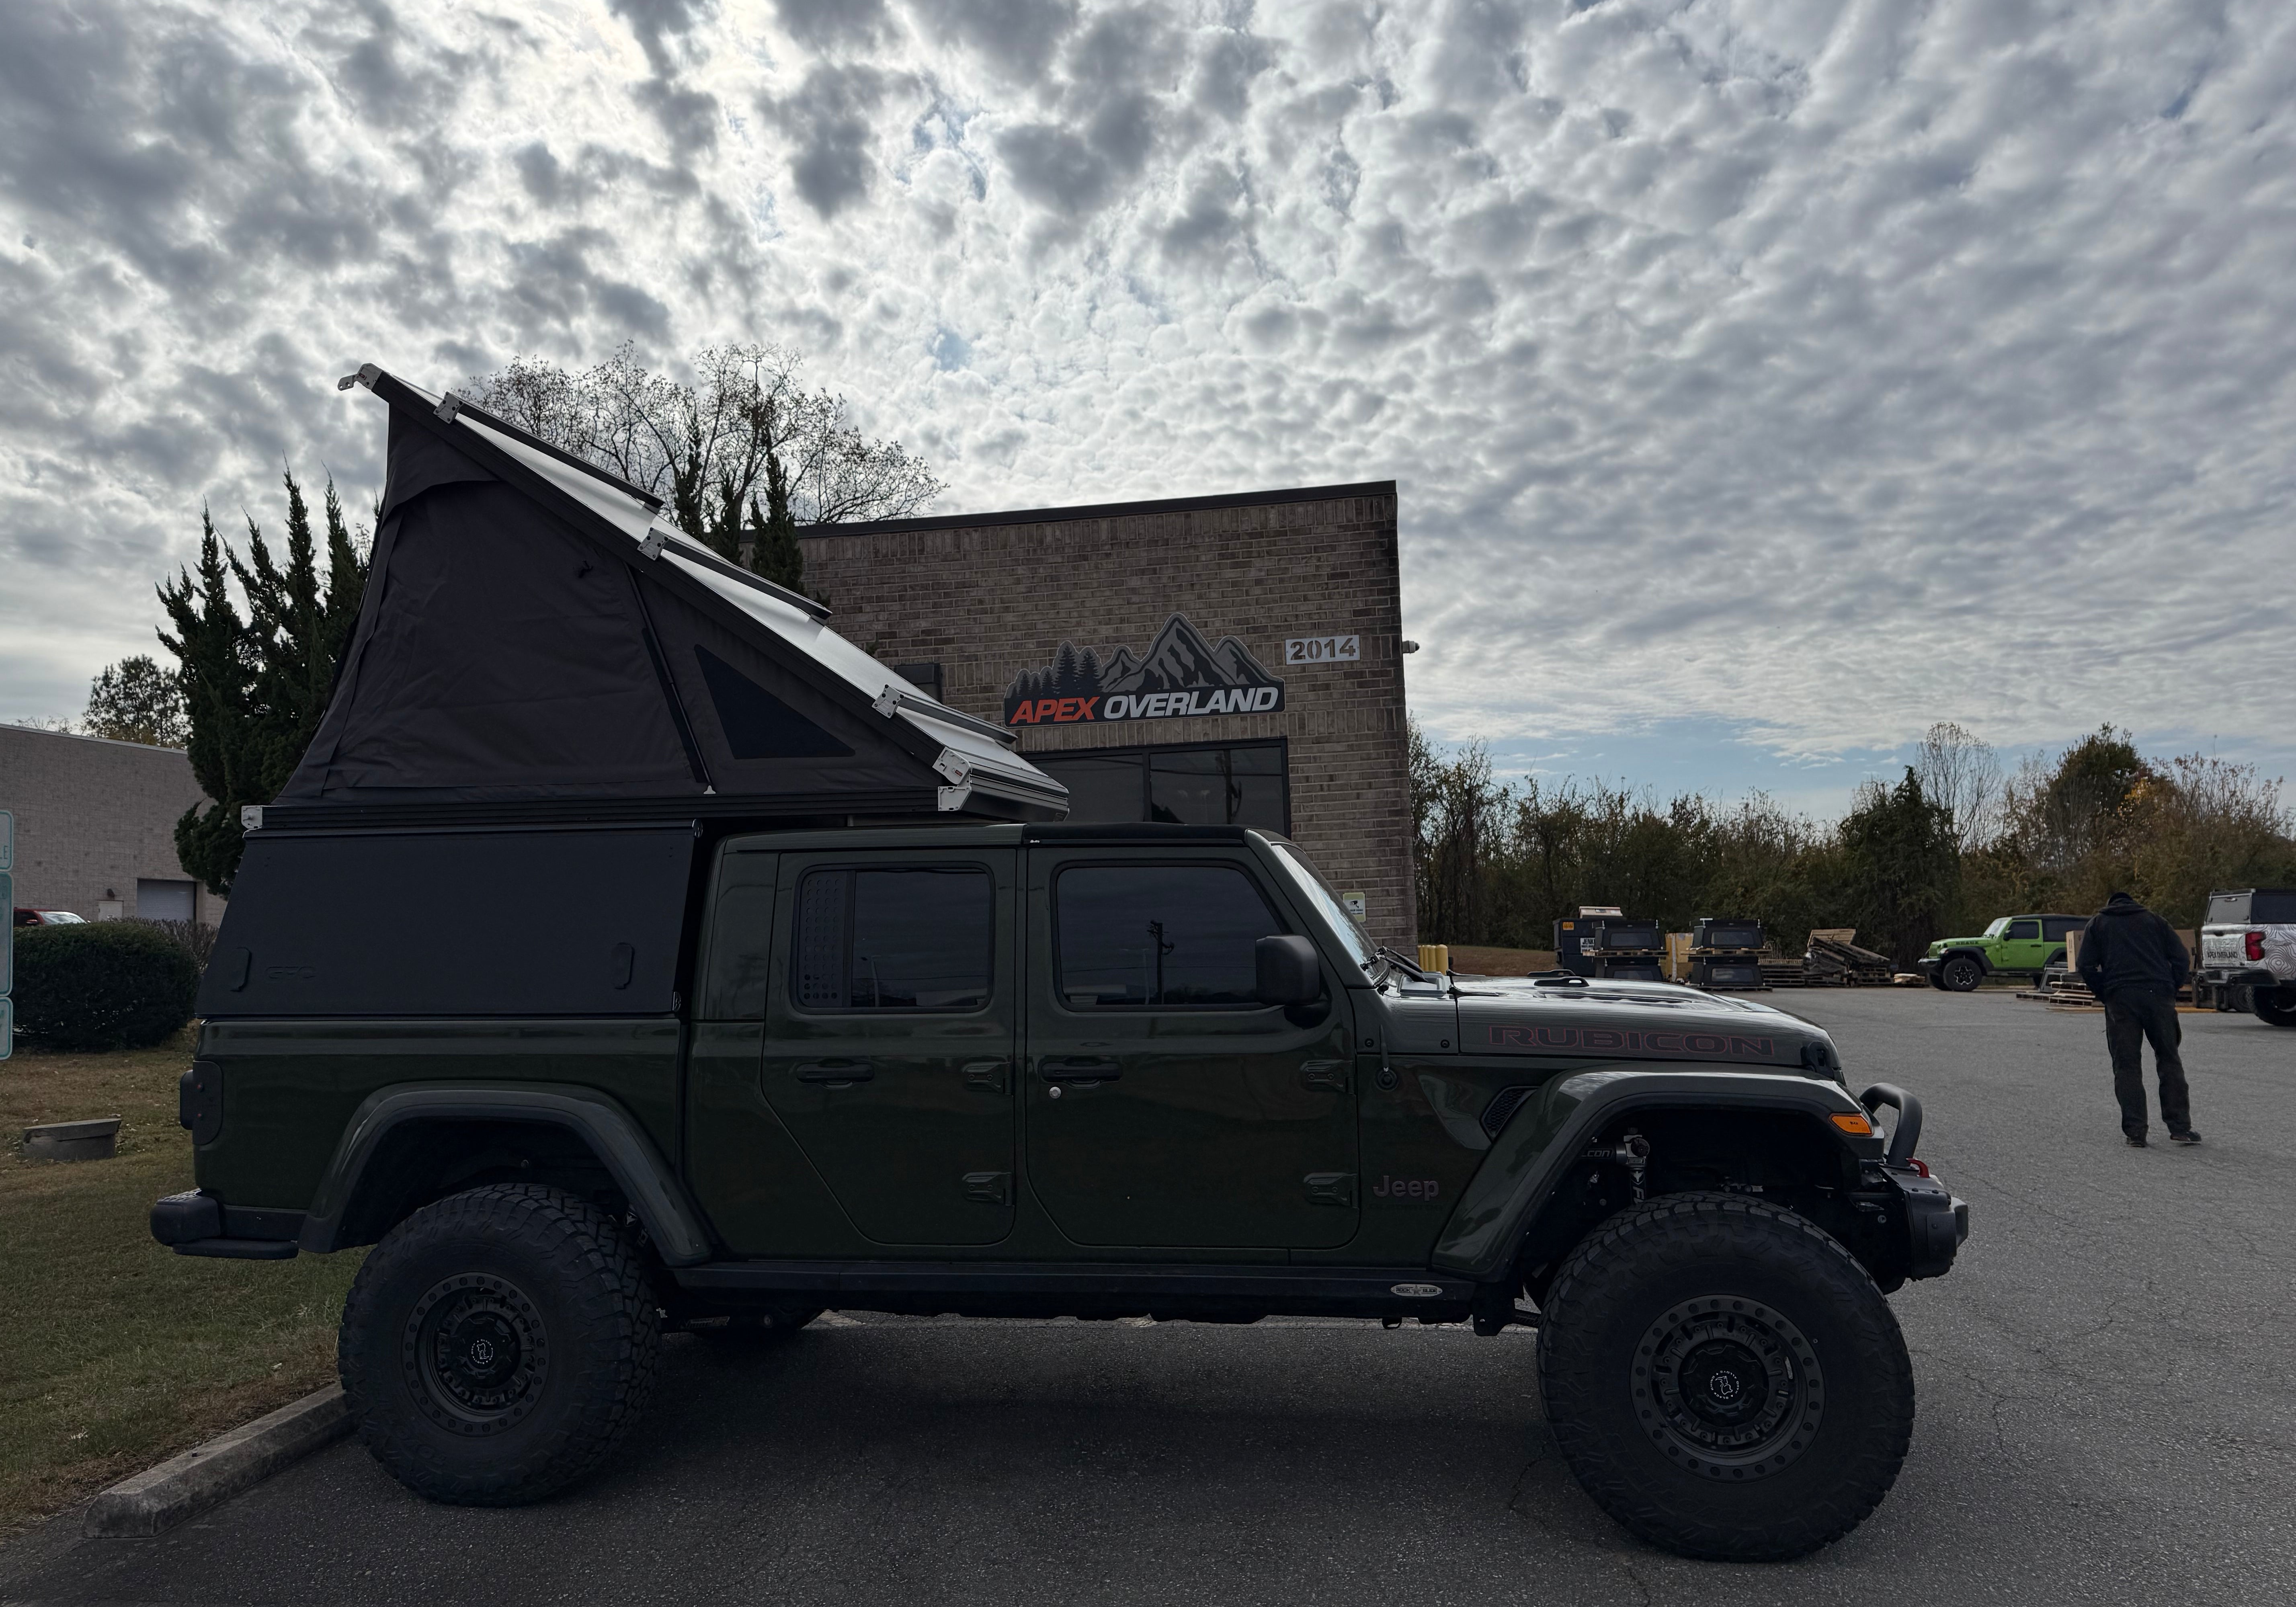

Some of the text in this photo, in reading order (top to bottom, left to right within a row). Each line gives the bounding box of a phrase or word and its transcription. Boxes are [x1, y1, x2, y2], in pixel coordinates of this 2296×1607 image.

[1290, 637, 1355, 660] 2014
[1010, 687, 1279, 724] APEX OVERLAND
[1488, 1026, 1775, 1056] RUBICON
[1373, 1175, 1439, 1201] Jeep
